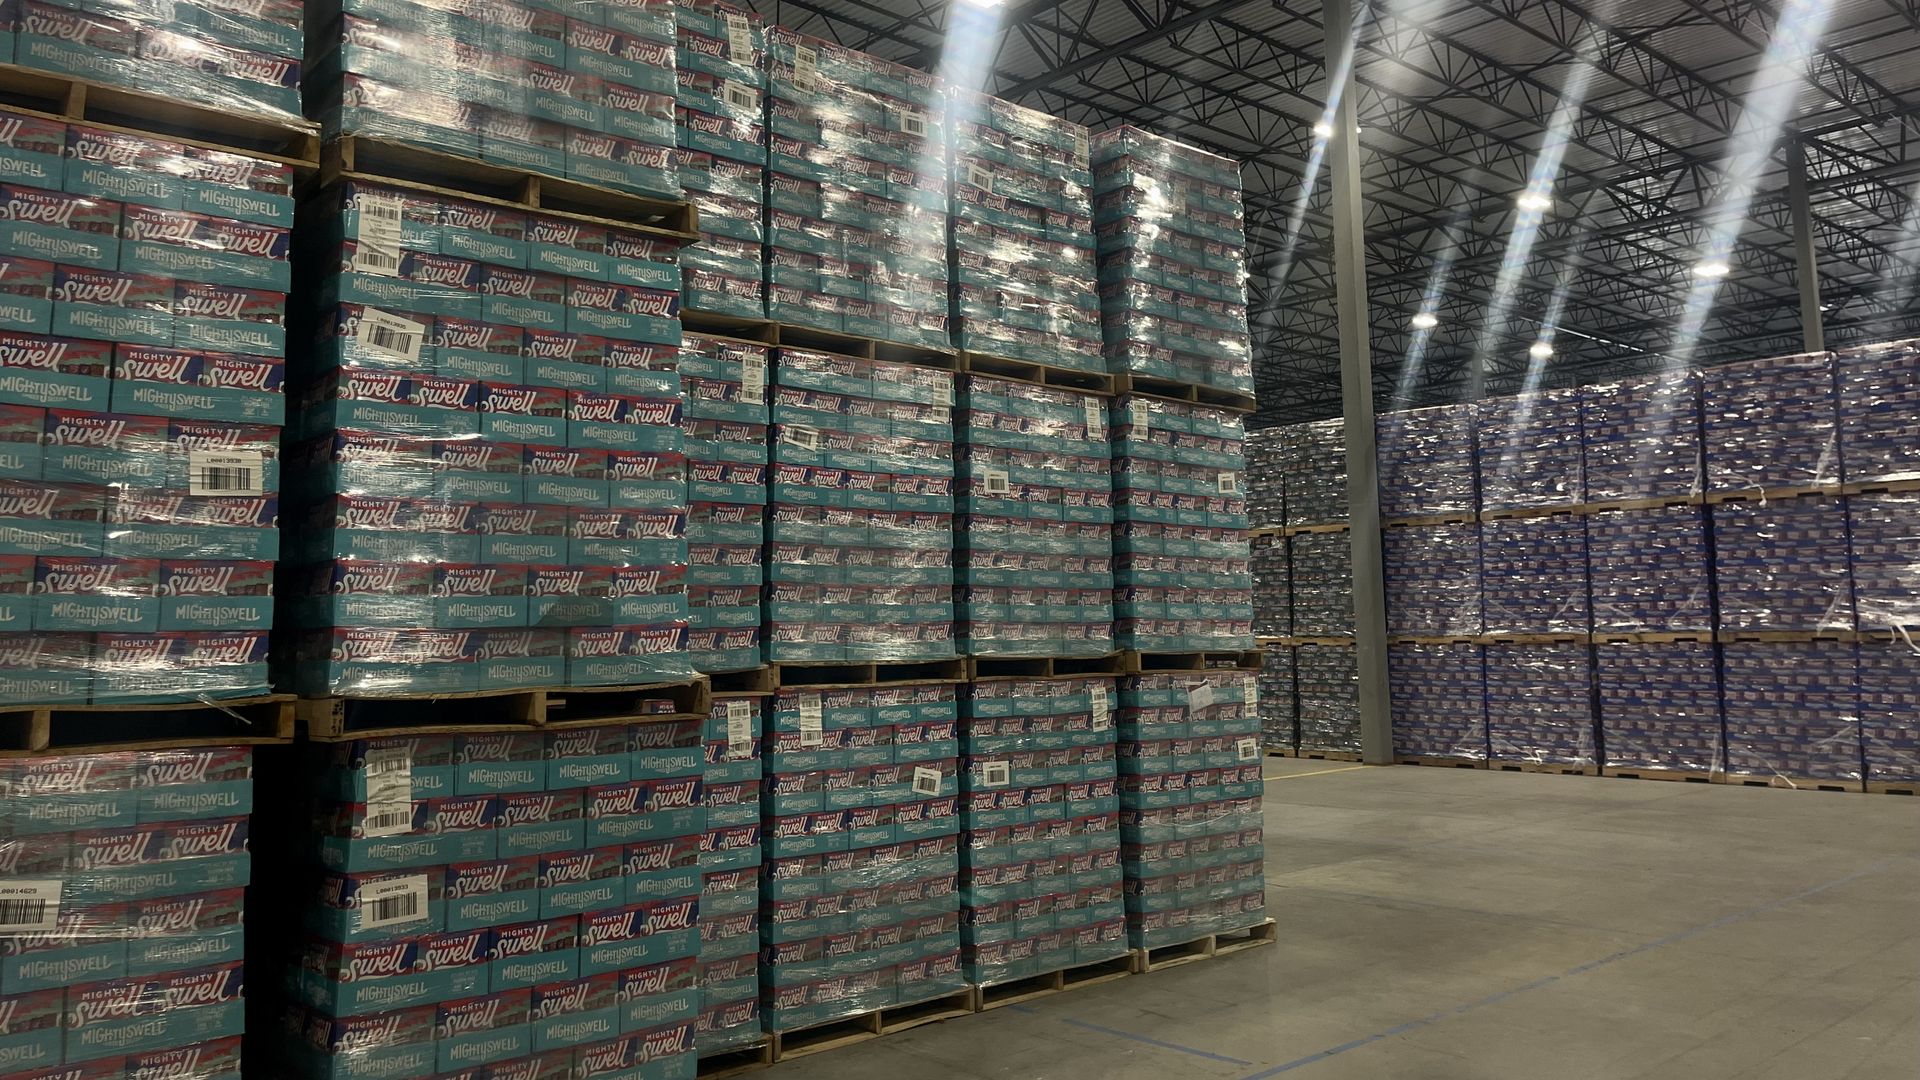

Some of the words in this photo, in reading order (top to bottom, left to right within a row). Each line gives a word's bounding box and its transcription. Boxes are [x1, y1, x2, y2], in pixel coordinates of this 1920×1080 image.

[130, 352, 172, 362] MIGHTY
[215, 360, 256, 370] MIGHTY
[423, 380, 455, 388] MIGHTY
[492, 388, 523, 396] MIGHTY
